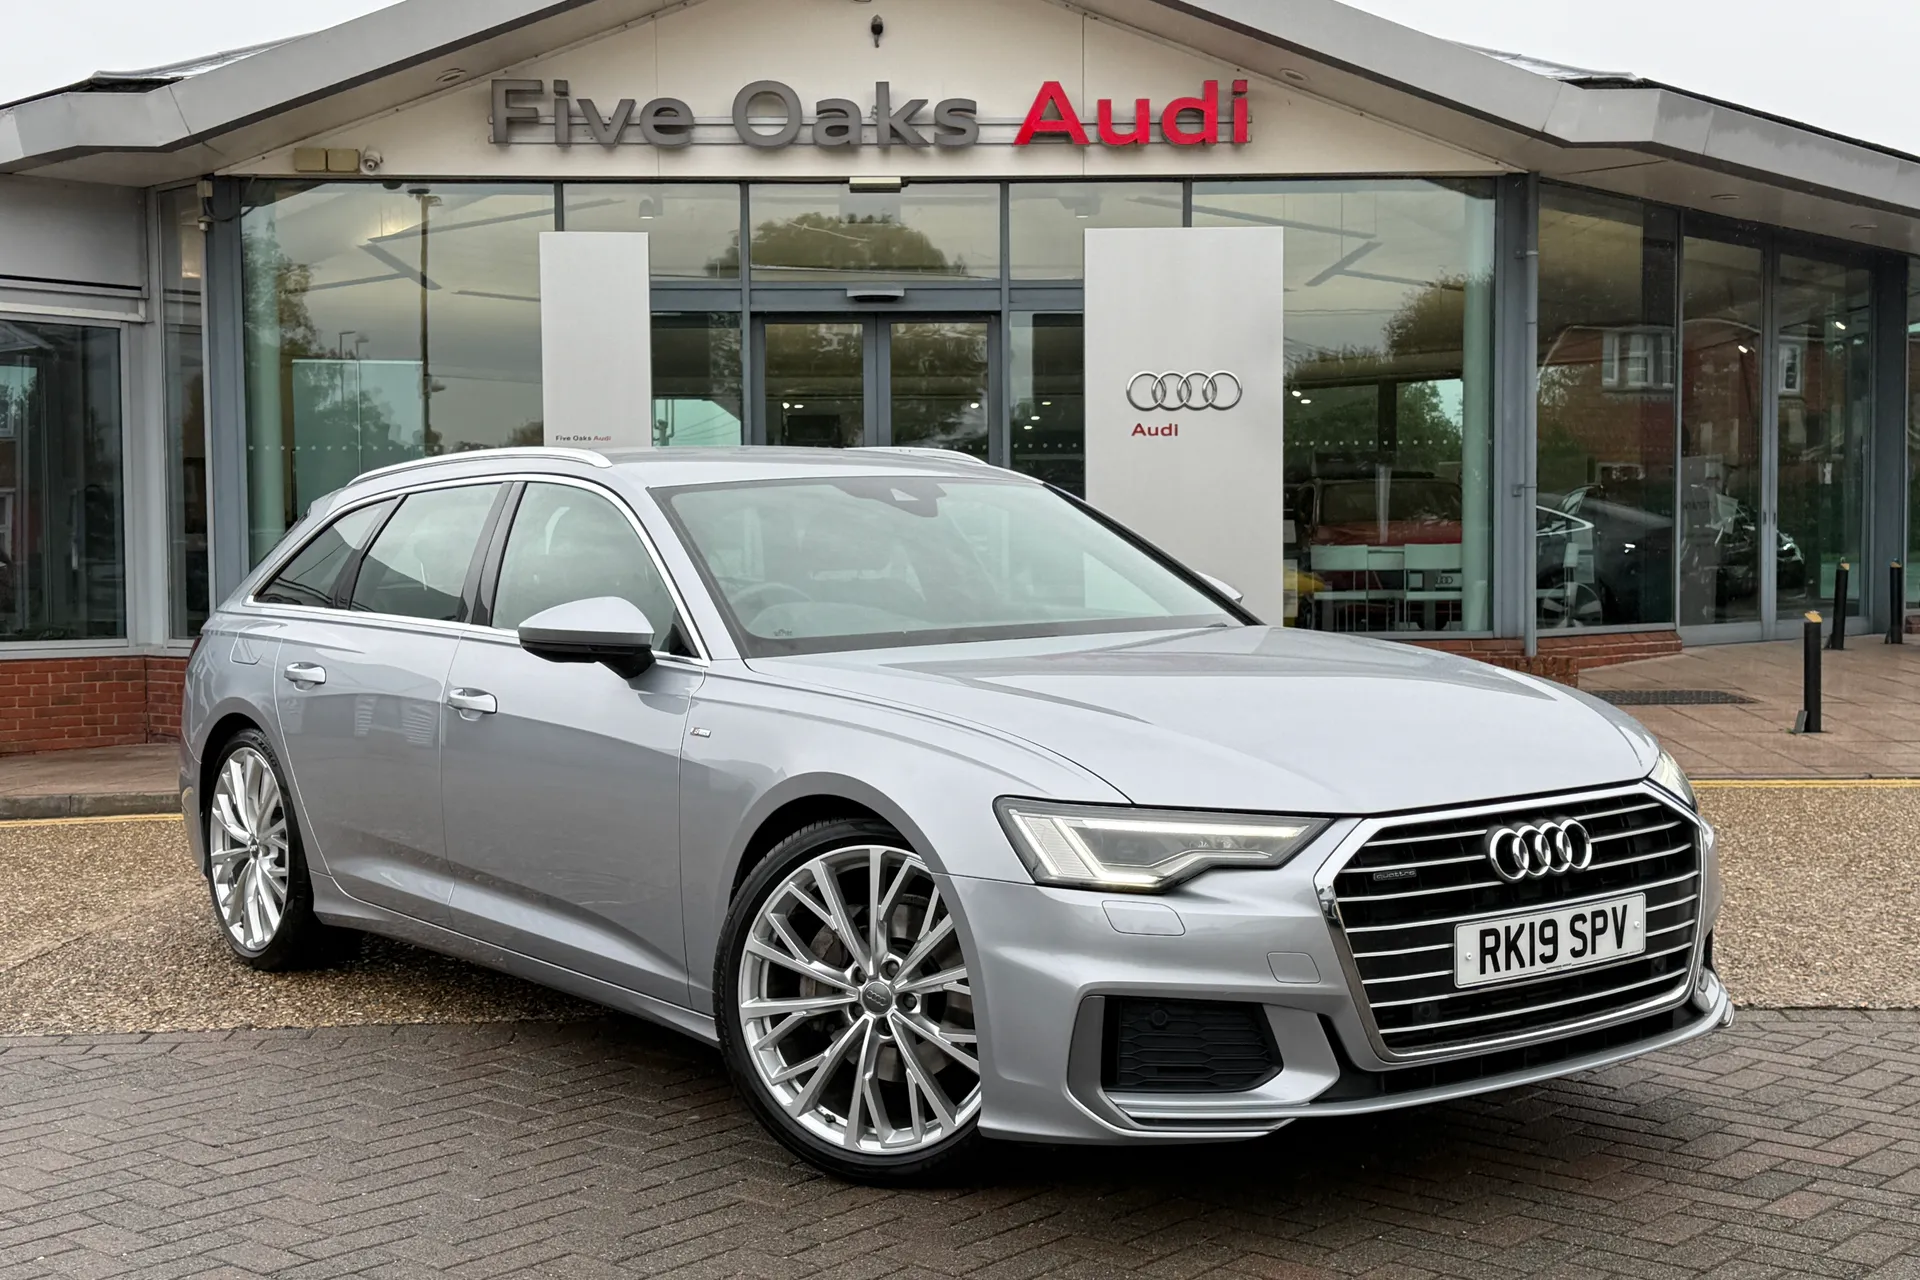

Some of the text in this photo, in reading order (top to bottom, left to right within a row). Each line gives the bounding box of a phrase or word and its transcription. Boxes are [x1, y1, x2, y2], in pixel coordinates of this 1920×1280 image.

[491, 79, 1248, 148] Five Oaks Audi
[1131, 422, 1178, 436] Audi
[1375, 870, 1416, 879] quattro
[1479, 904, 1628, 975] RK19 SPV
